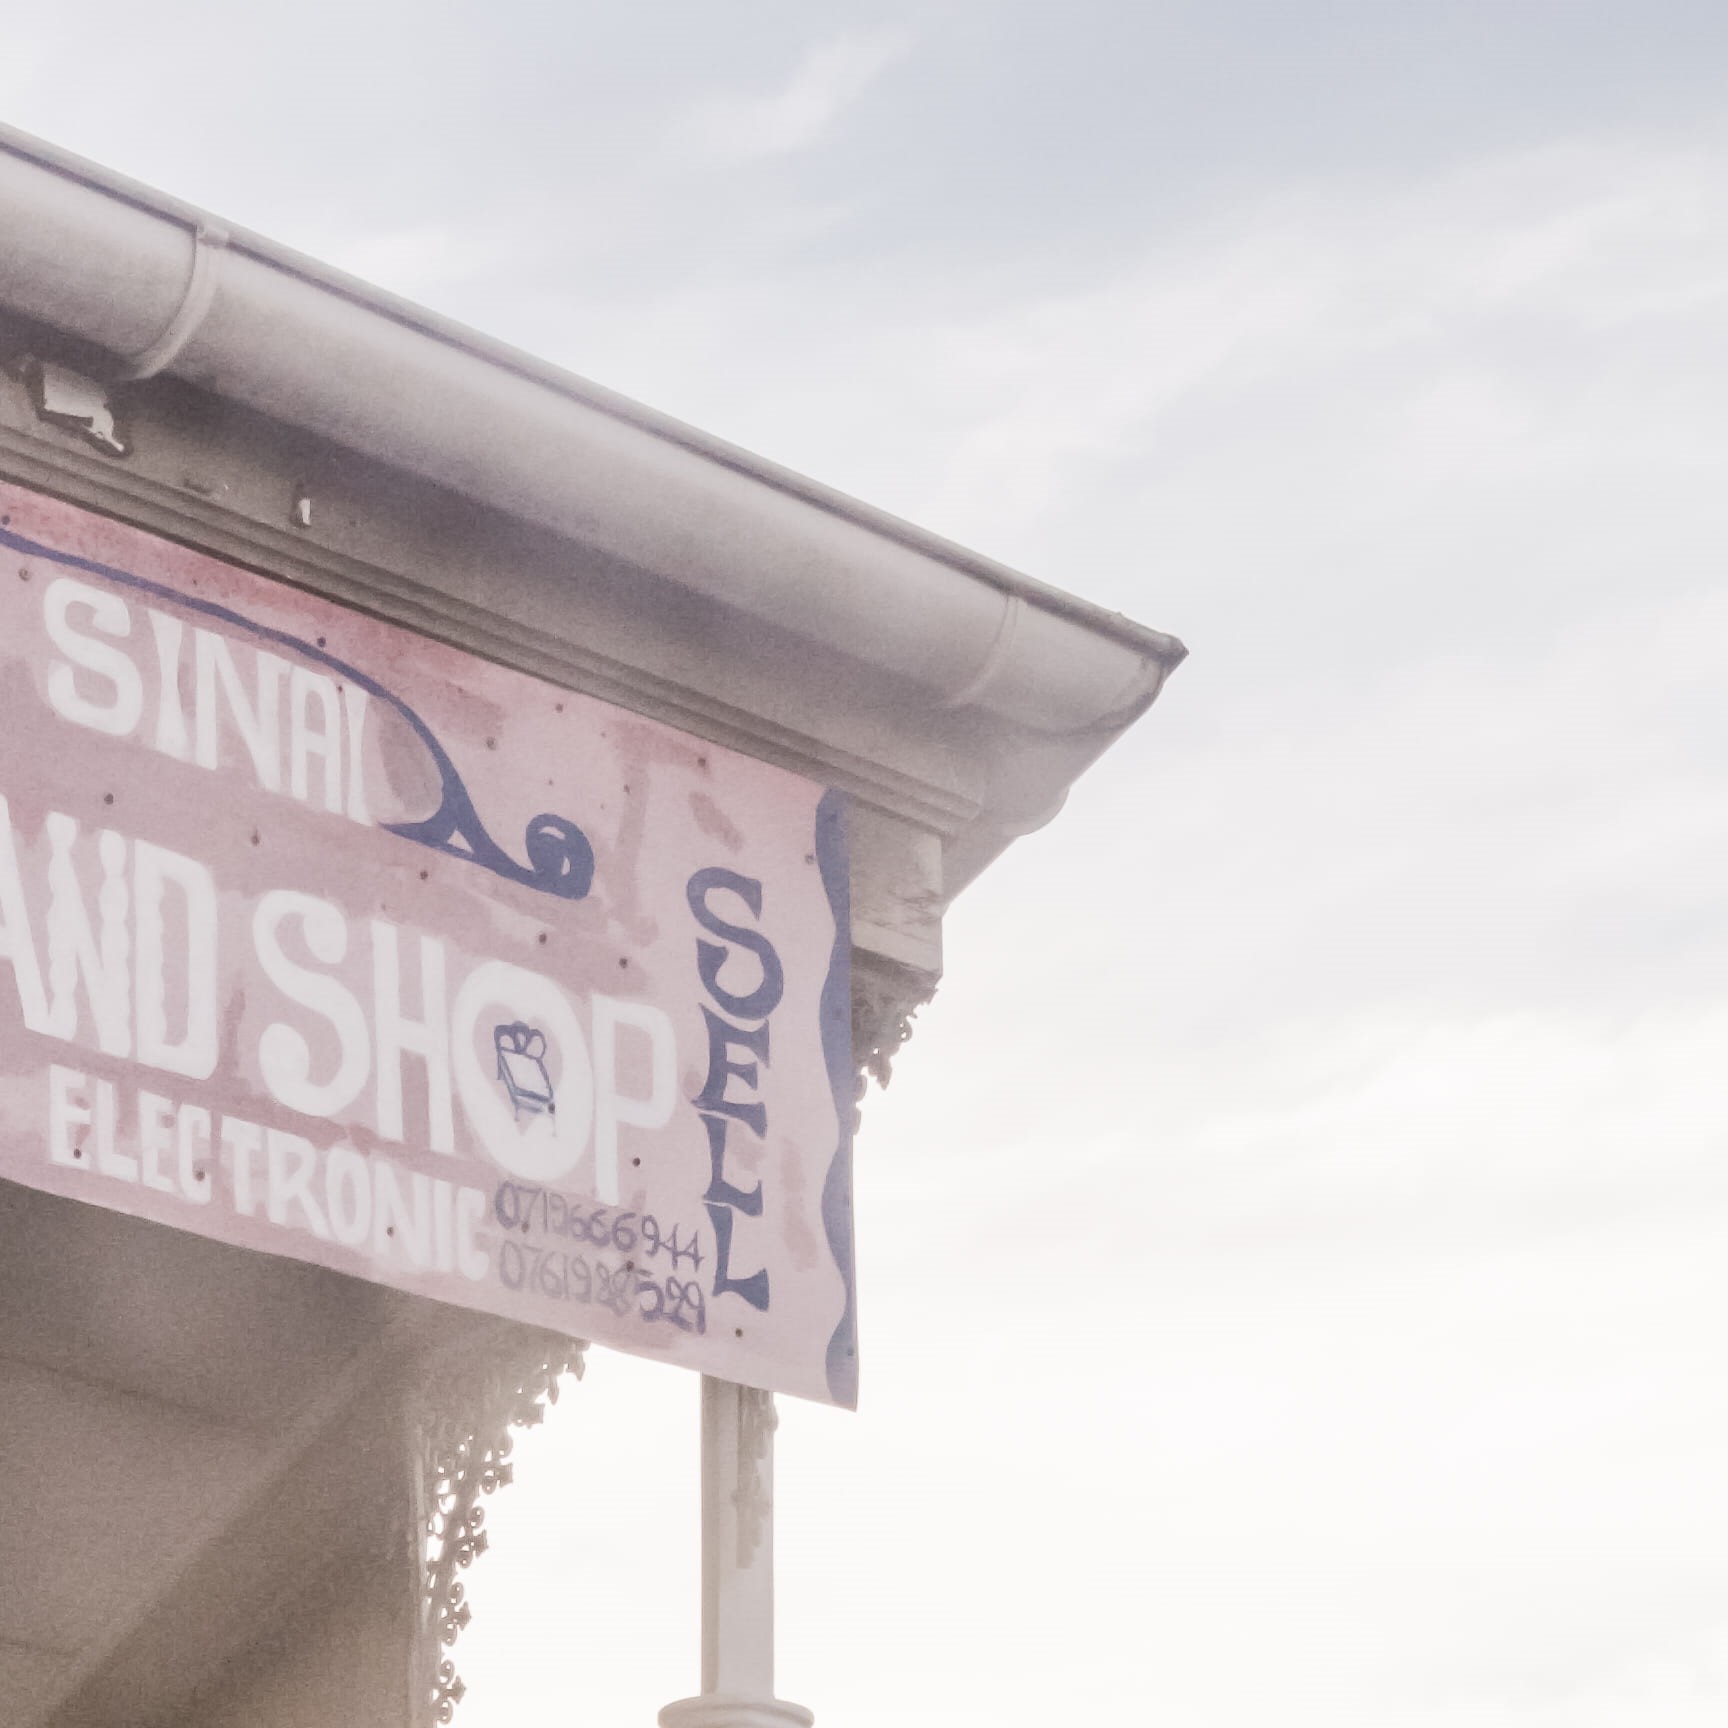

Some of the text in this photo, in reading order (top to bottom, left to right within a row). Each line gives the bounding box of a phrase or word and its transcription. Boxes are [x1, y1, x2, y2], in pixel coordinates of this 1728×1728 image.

[44, 577, 372, 826] SINAI
[47, 1062, 491, 1284] ELECTRONIC
[253, 888, 678, 1208] SHOP
[685, 866, 785, 1312] SELL
